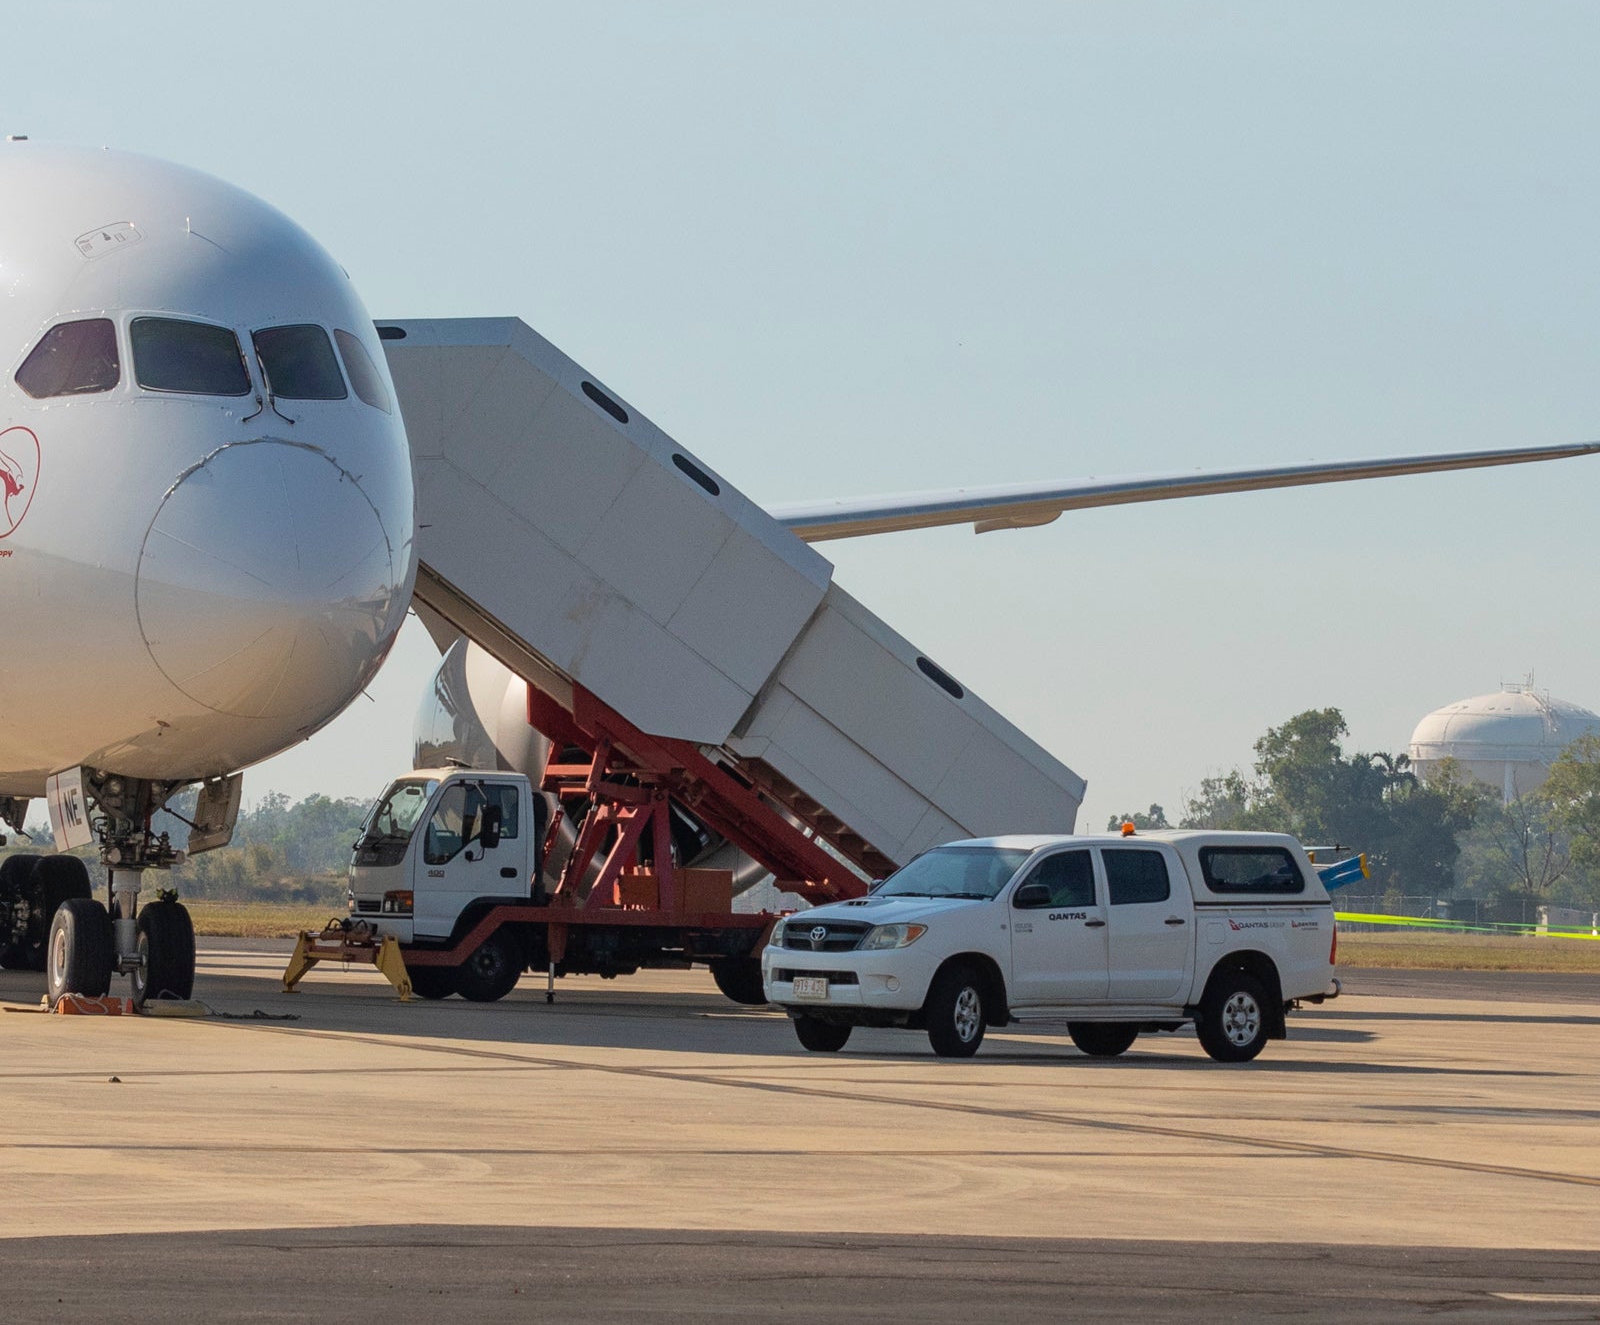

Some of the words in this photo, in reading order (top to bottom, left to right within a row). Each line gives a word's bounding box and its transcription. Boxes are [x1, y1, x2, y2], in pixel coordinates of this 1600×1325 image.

[63, 788, 82, 828] NE
[1049, 913, 1086, 921] QANTAS
[1239, 921, 1268, 929] QANTAS
